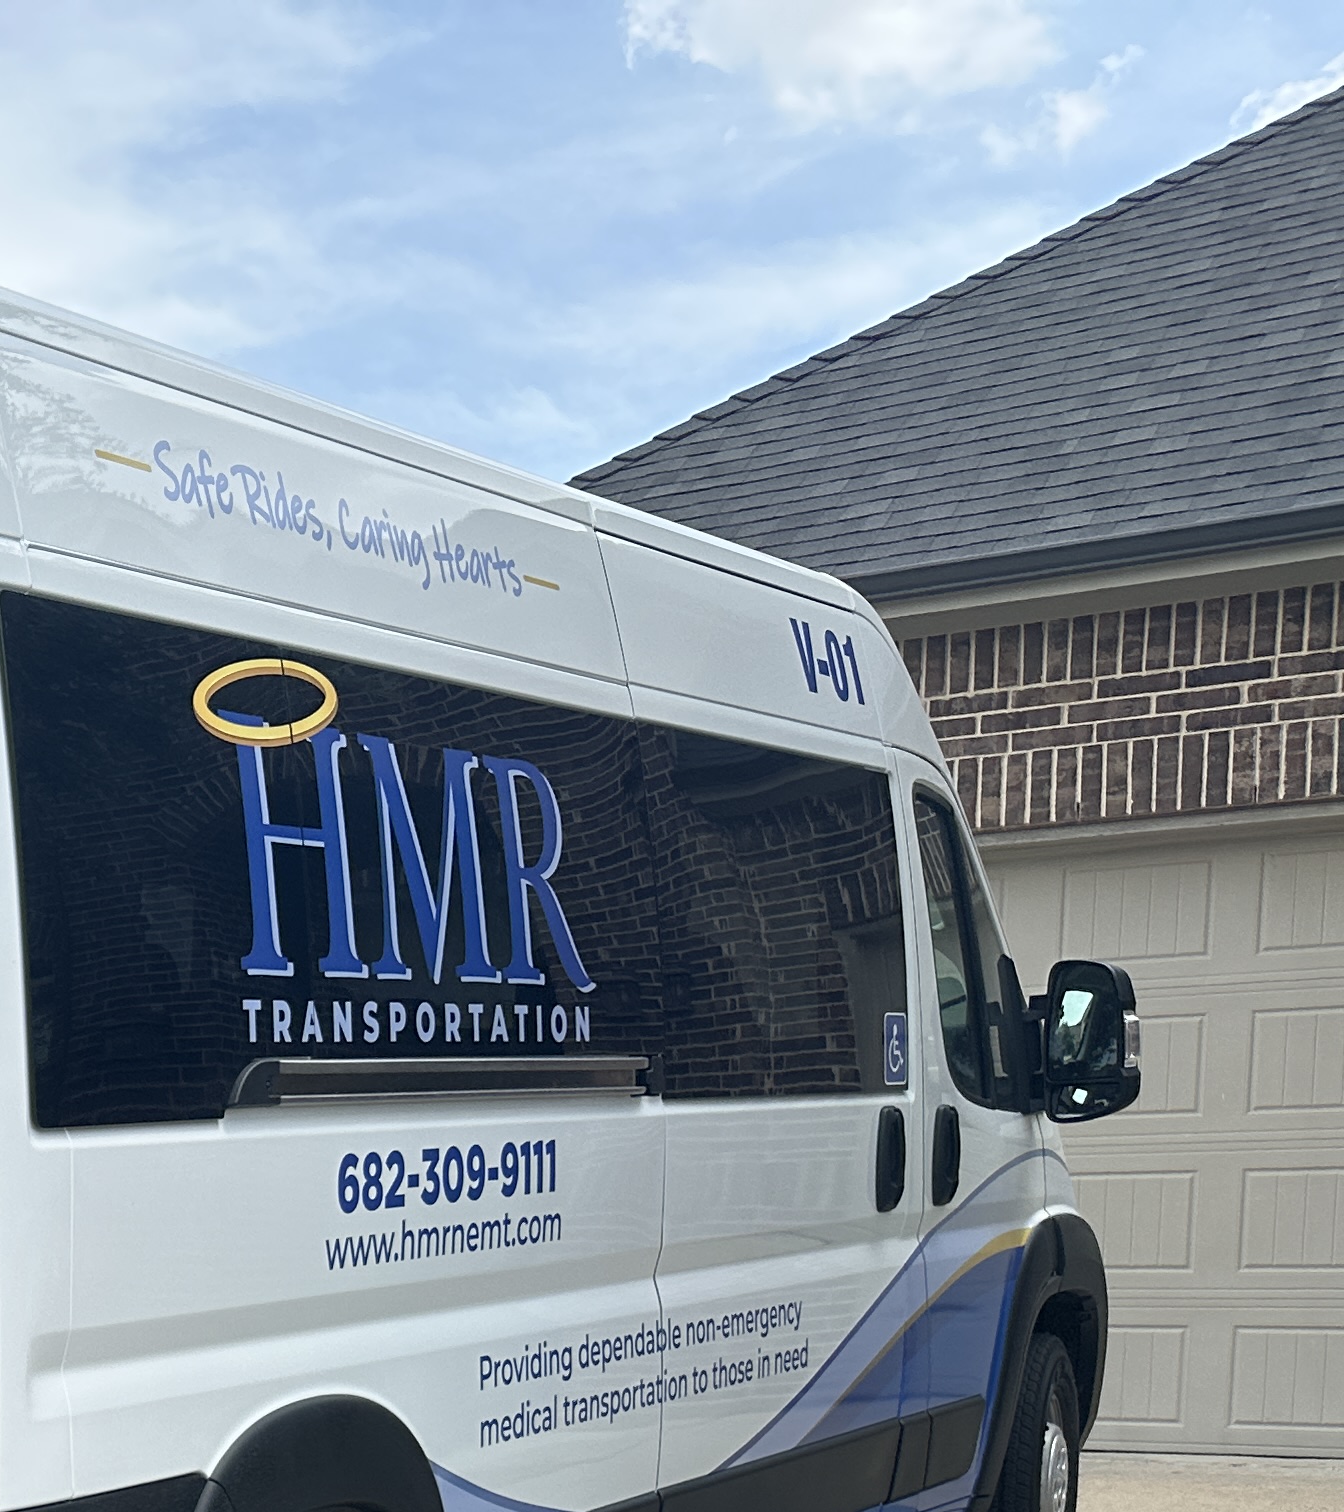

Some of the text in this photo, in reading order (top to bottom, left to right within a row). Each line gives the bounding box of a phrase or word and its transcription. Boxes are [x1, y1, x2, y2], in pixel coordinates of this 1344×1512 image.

[153, 440, 522, 598] Safe Rides, Caring Hearts
[789, 618, 866, 706] V-01
[217, 709, 597, 994] HMR
[242, 999, 591, 1043] TRANSPORTATION
[338, 1139, 557, 1214] 682-309-9111
[325, 1212, 562, 1271] www.hmrnemt.com
[479, 1300, 803, 1391] Providing dependable non-emergency
[480, 1337, 809, 1448] medical transportation to those in need
